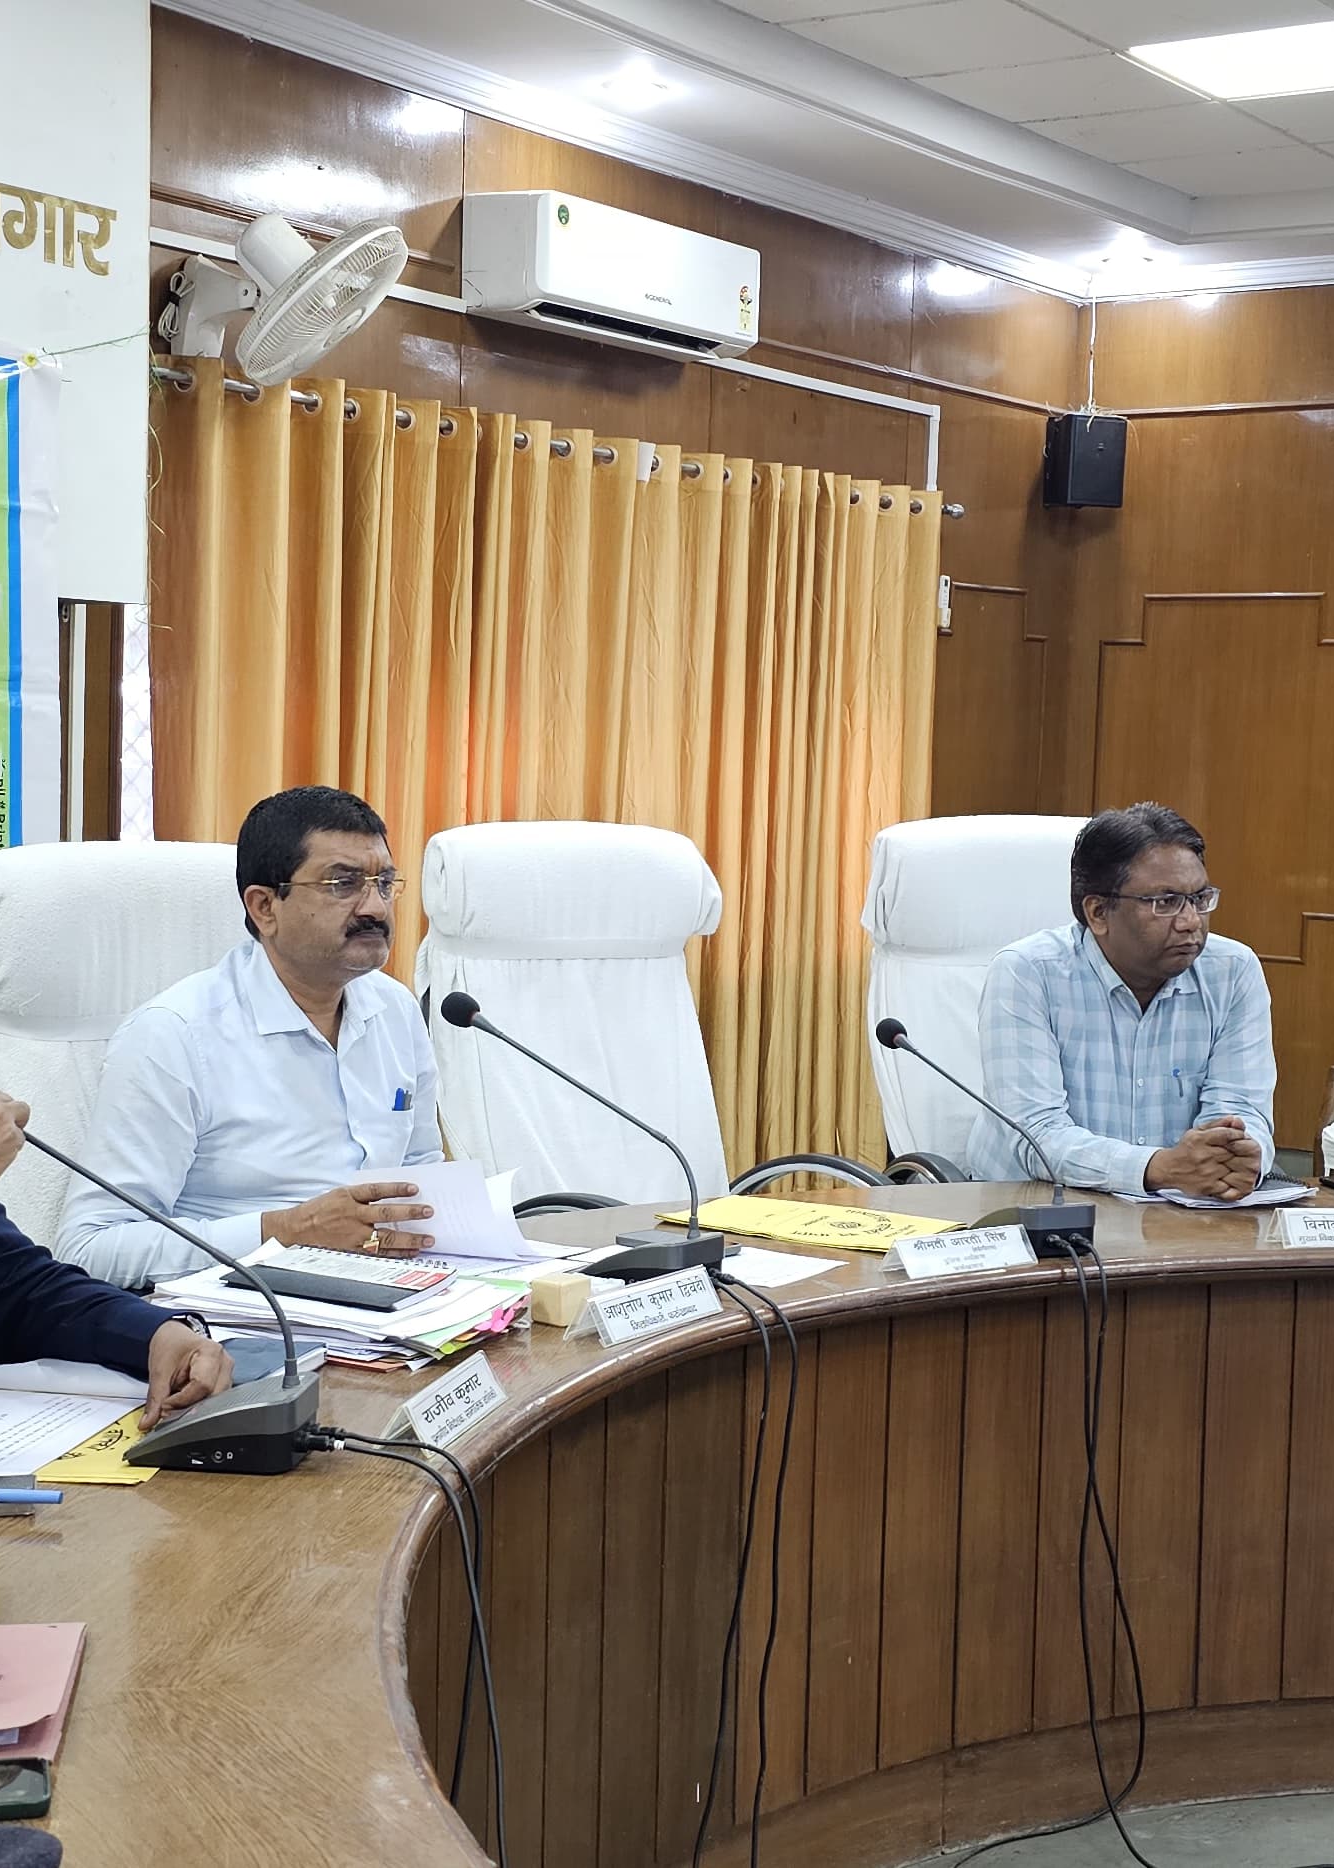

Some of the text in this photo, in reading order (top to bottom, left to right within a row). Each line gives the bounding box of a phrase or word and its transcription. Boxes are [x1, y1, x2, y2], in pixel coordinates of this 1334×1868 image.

[913, 1230, 1008, 1252] श्रीमती आरती सिंह
[647, 1288, 676, 1310] कुमार
[421, 1372, 482, 1424] राजीव कुमार
